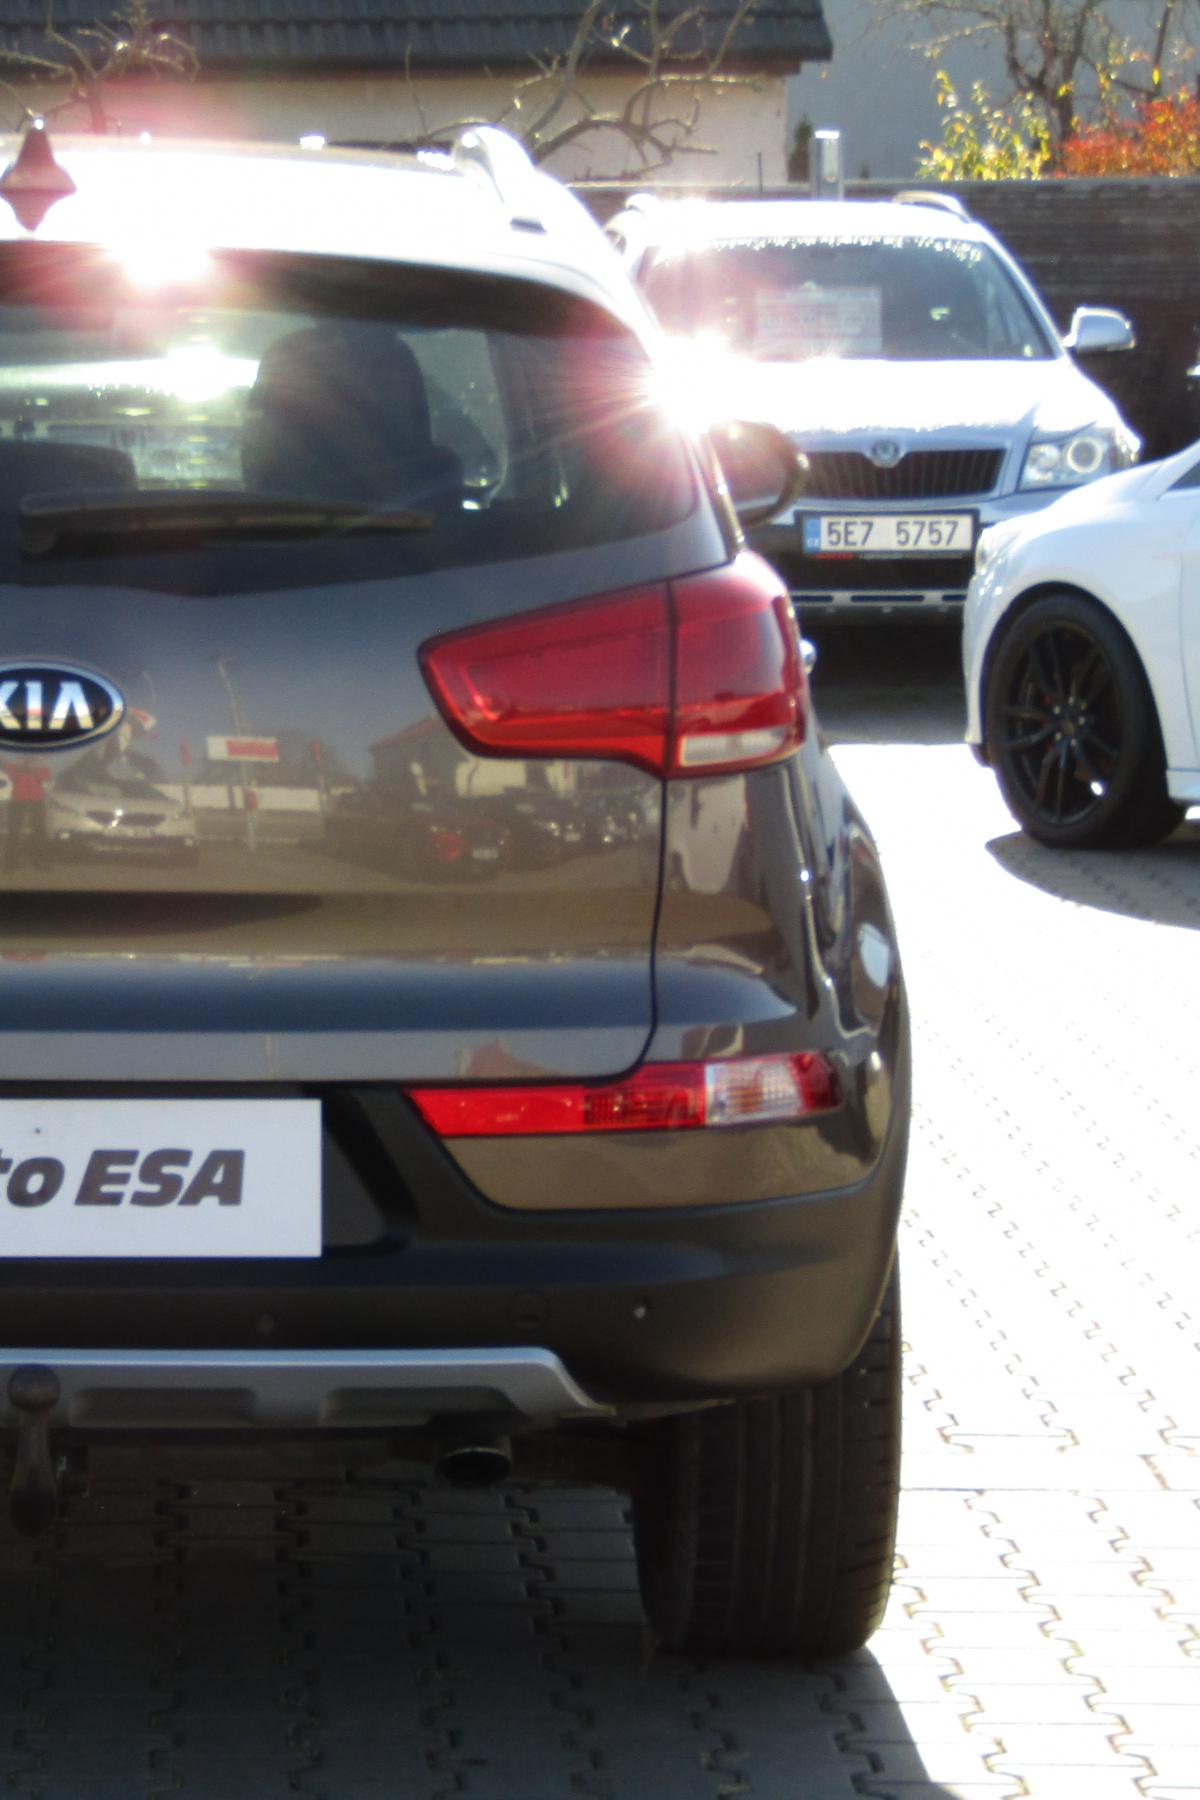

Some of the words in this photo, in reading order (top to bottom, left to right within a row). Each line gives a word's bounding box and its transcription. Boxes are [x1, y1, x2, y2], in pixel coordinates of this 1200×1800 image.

[826, 520, 874, 547] 5E7
[895, 520, 959, 547] 5757
[73, 1148, 246, 1208] ESA
